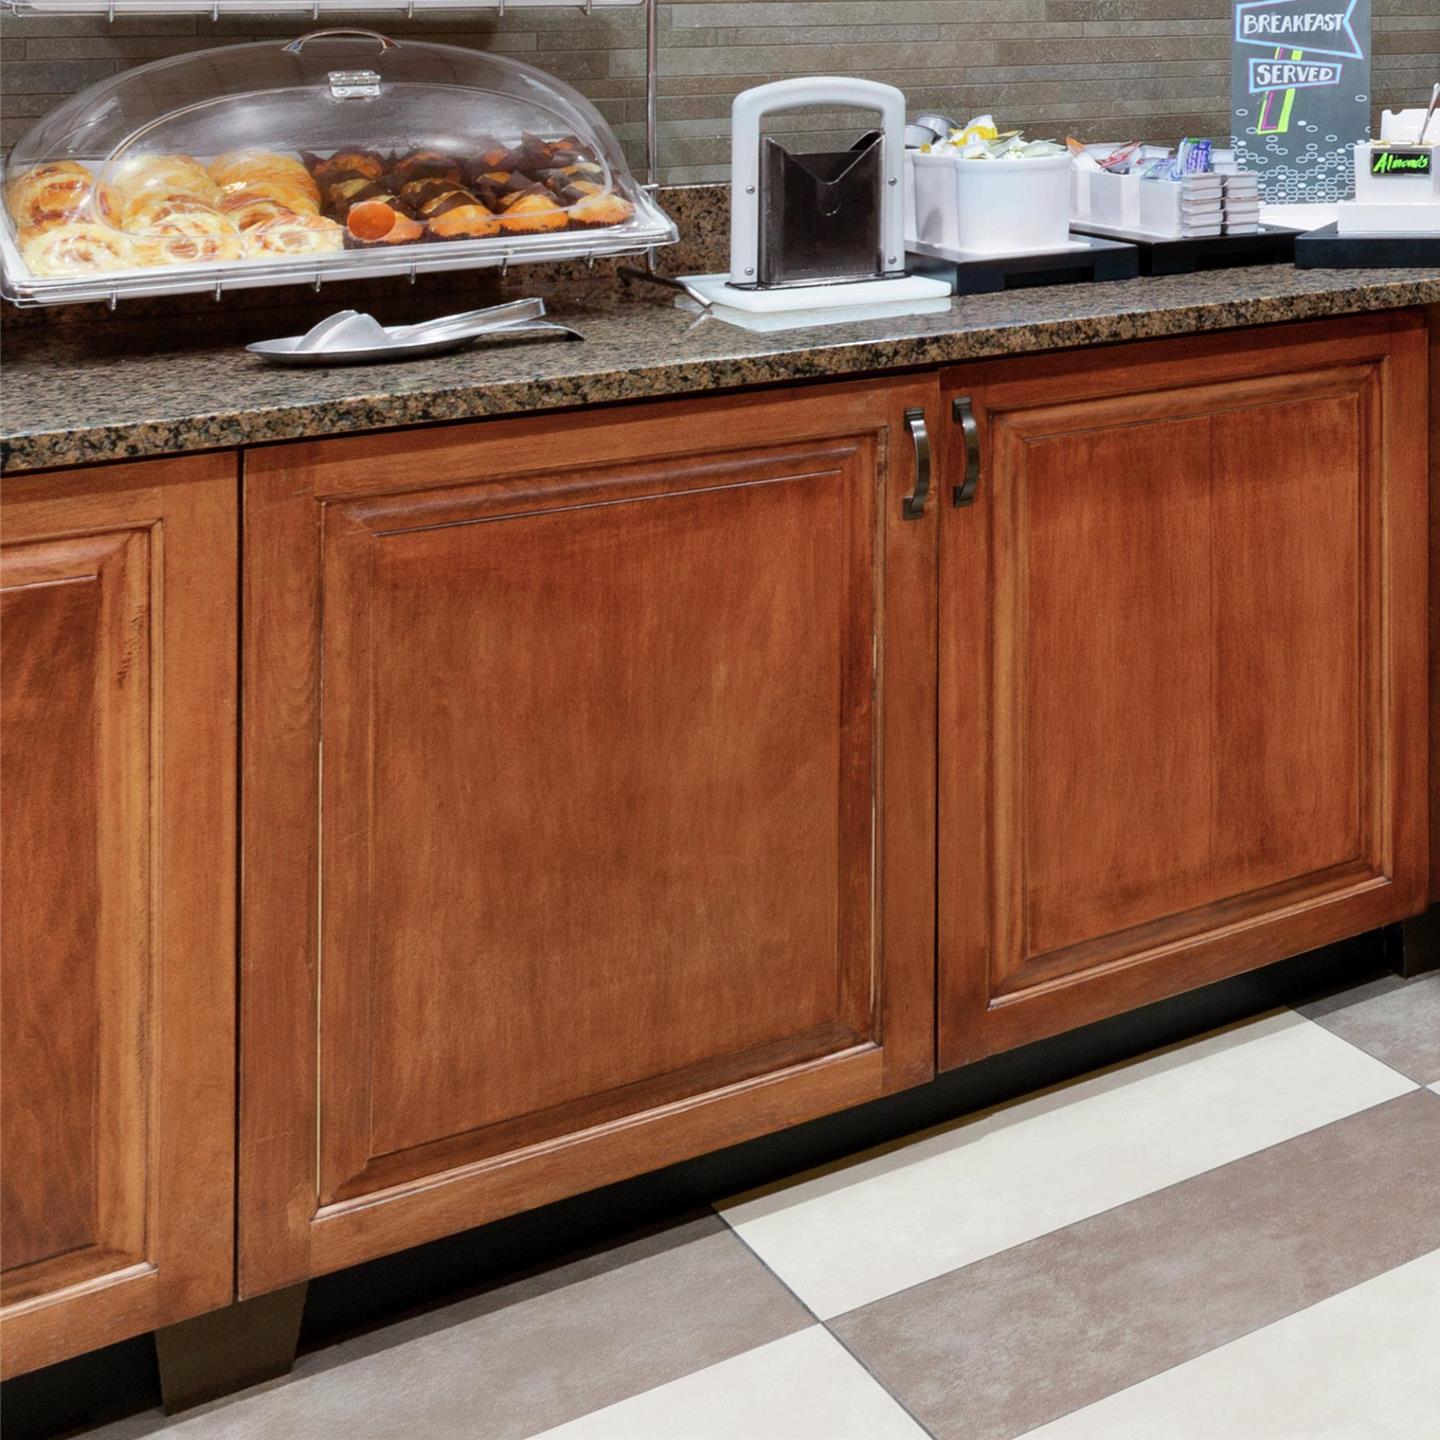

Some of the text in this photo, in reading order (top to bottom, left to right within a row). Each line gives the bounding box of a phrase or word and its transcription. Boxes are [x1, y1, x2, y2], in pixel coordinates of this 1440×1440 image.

[1243, 13, 1345, 34] BREAKFAST
[1256, 64, 1333, 85] SERVED
[1373, 152, 1431, 173] Almonds
